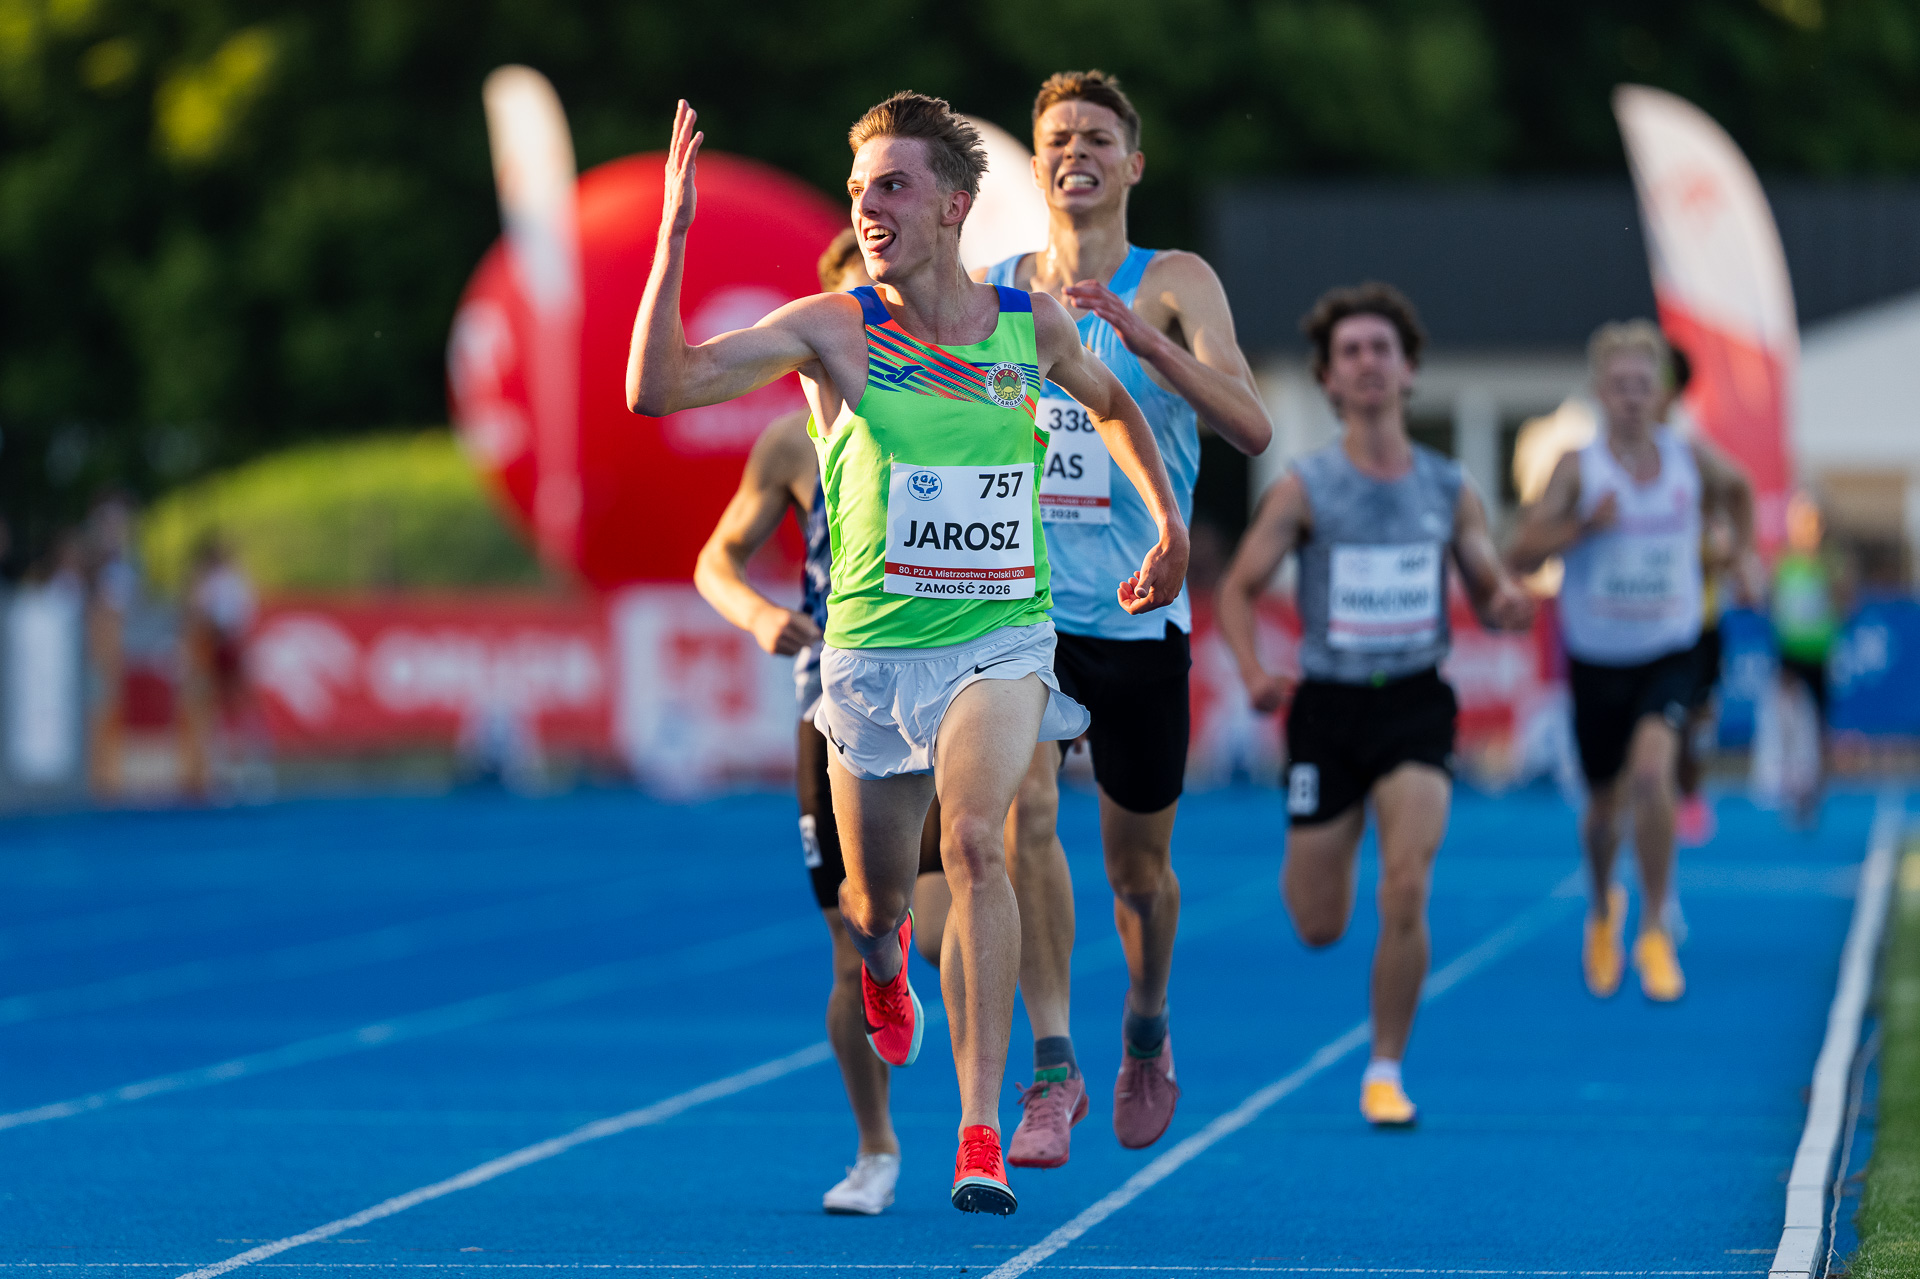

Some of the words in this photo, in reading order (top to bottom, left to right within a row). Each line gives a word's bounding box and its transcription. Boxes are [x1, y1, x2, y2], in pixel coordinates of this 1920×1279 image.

[987, 366, 1001, 387] WMLKS
[1004, 363, 1026, 385] POMORZE
[997, 370, 1017, 379] LZS
[992, 393, 1024, 406] STARGARD
[1049, 408, 1096, 433] 338
[1042, 453, 1084, 479] AS
[912, 474, 938, 486] PGK
[978, 471, 1024, 499] 757
[1049, 508, 1080, 519] 2026
[903, 520, 1020, 551] JAROSZ
[898, 566, 912, 575] 80.
[913, 568, 933, 577] PZLA
[935, 570, 986, 579] Mistrzostwa
[988, 569, 1011, 579] Polski
[1012, 569, 1025, 578] U20
[915, 582, 975, 594] ZAMOŚĆ
[978, 584, 1011, 595] 2026
